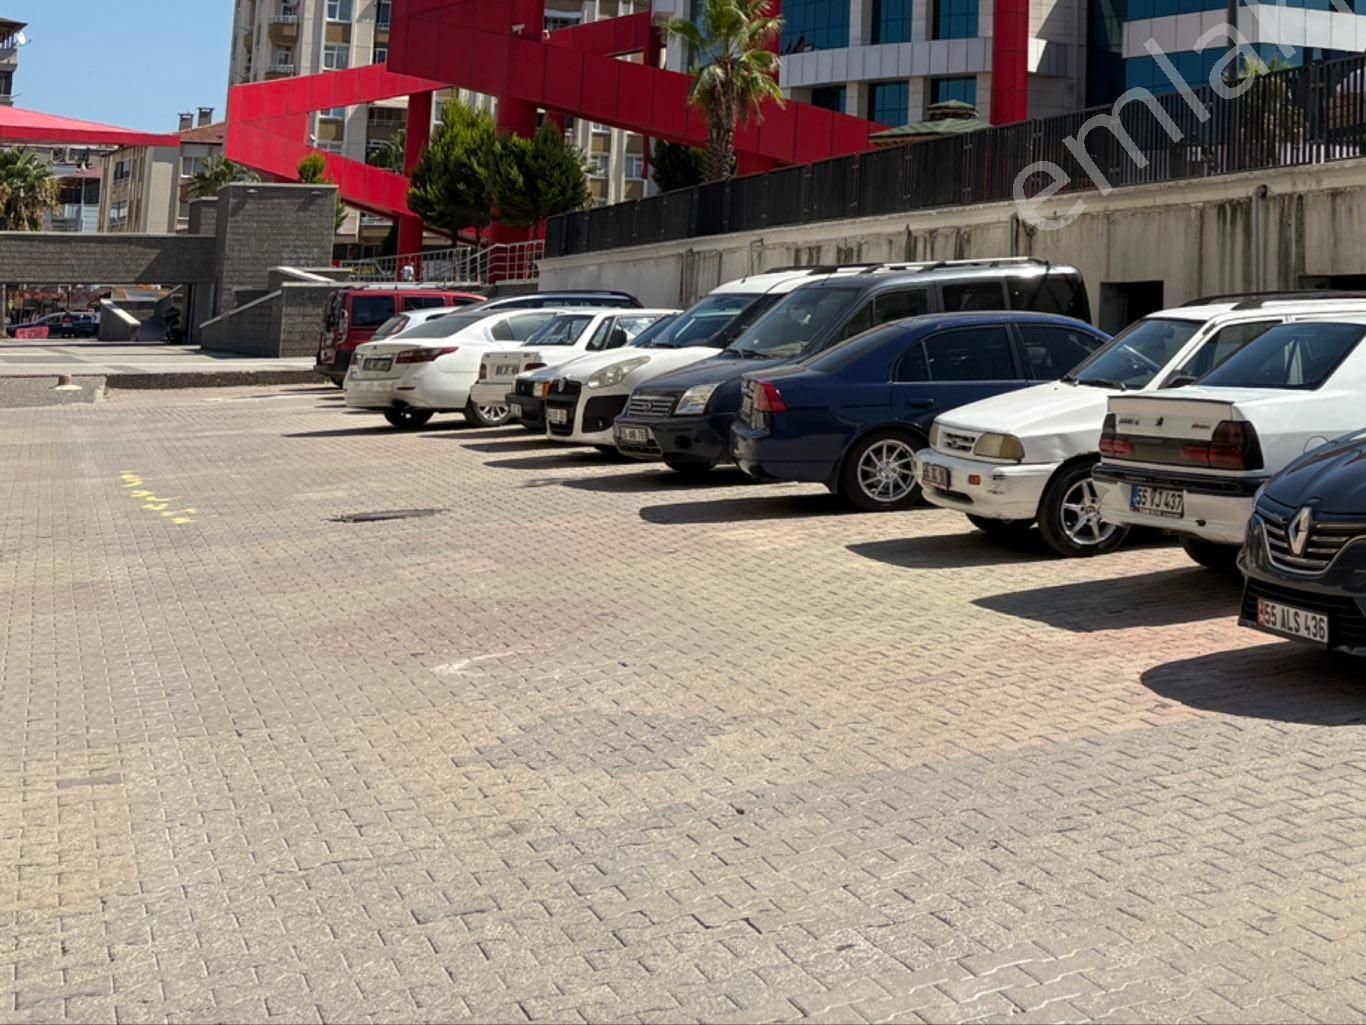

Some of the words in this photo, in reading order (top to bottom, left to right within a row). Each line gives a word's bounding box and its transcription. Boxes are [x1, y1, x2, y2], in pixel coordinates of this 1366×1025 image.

[1264, 603, 1277, 626] 55
[1281, 607, 1301, 633] ALS
[1304, 614, 1326, 640] 436
